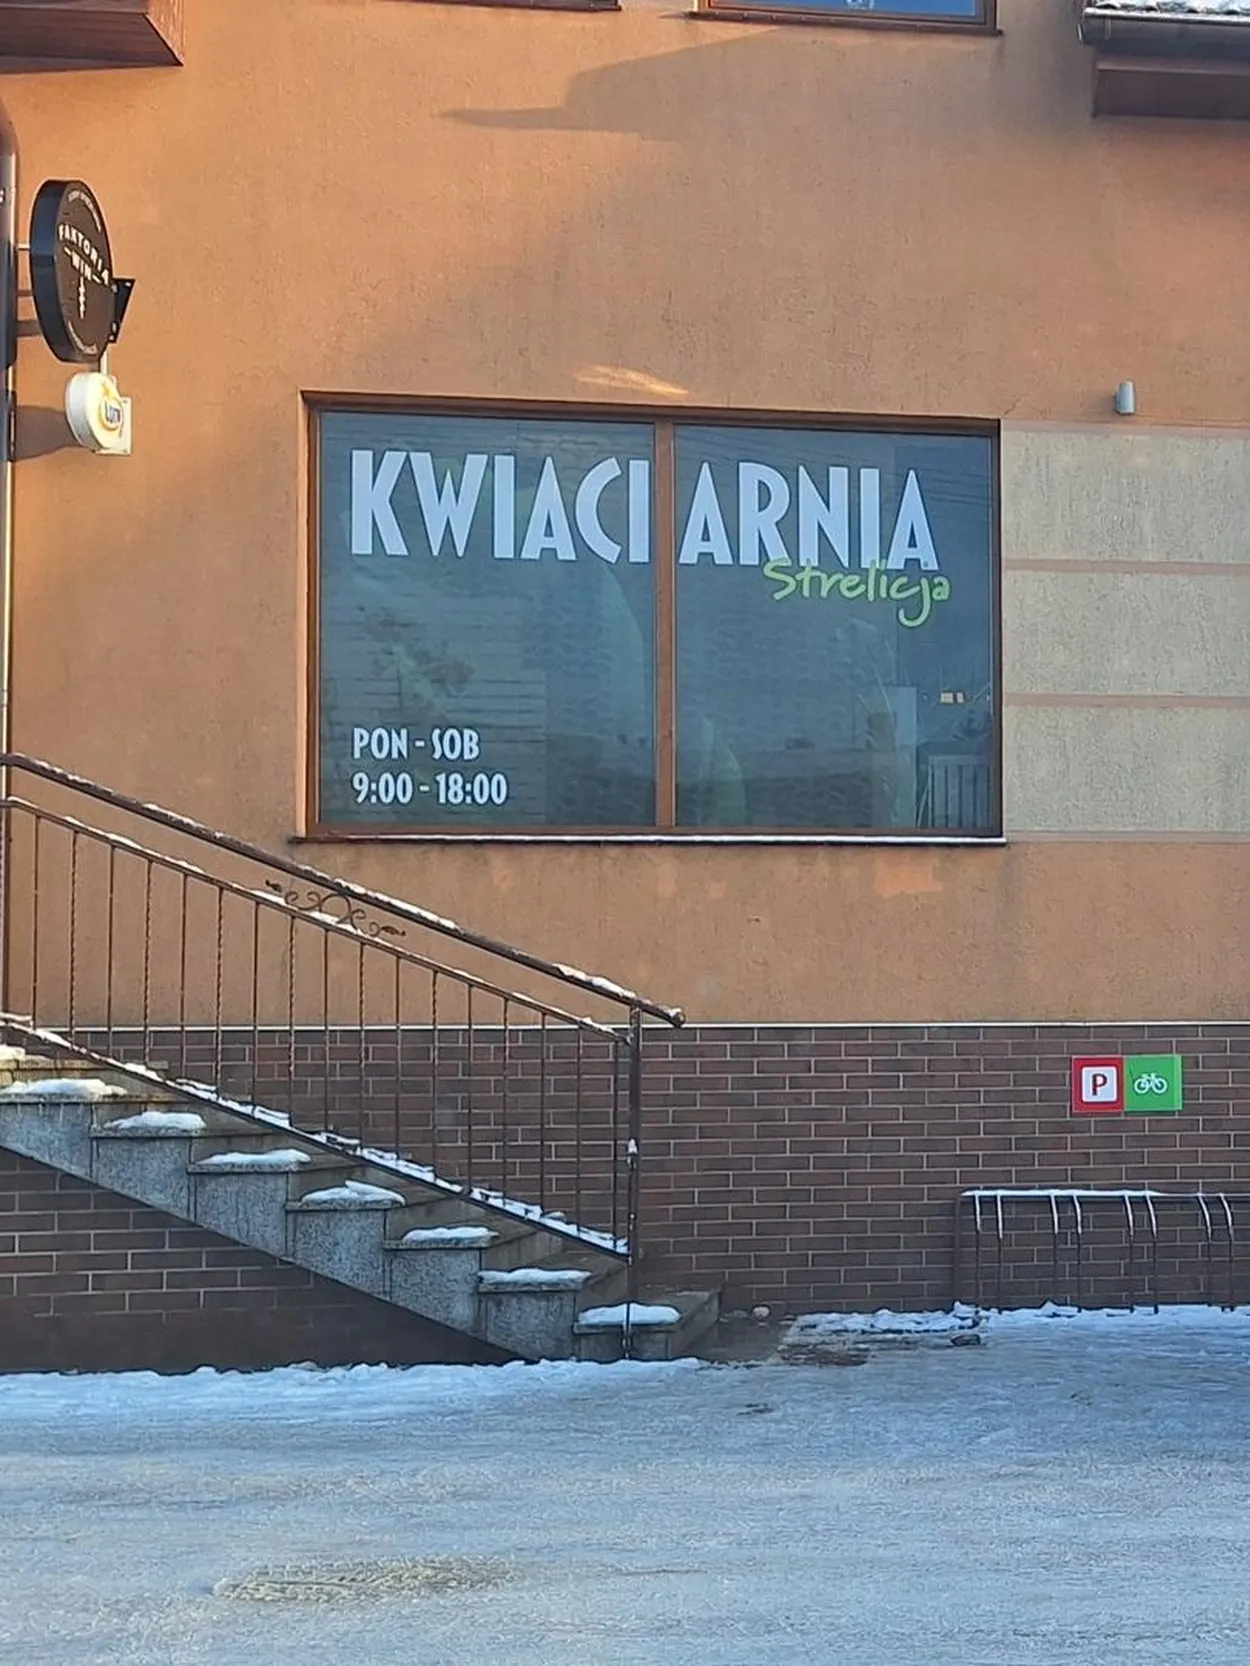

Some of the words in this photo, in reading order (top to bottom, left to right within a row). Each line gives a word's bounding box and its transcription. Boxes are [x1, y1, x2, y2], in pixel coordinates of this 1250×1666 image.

[58, 223, 109, 286] FAKTORIA
[71, 250, 92, 281] WIN
[762, 555, 951, 628] Strelicja
[351, 728, 408, 761] PON
[431, 728, 480, 762] SOB
[351, 773, 414, 805] 9:00
[435, 773, 508, 806] 18:00
[1091, 1073, 1108, 1097] P
